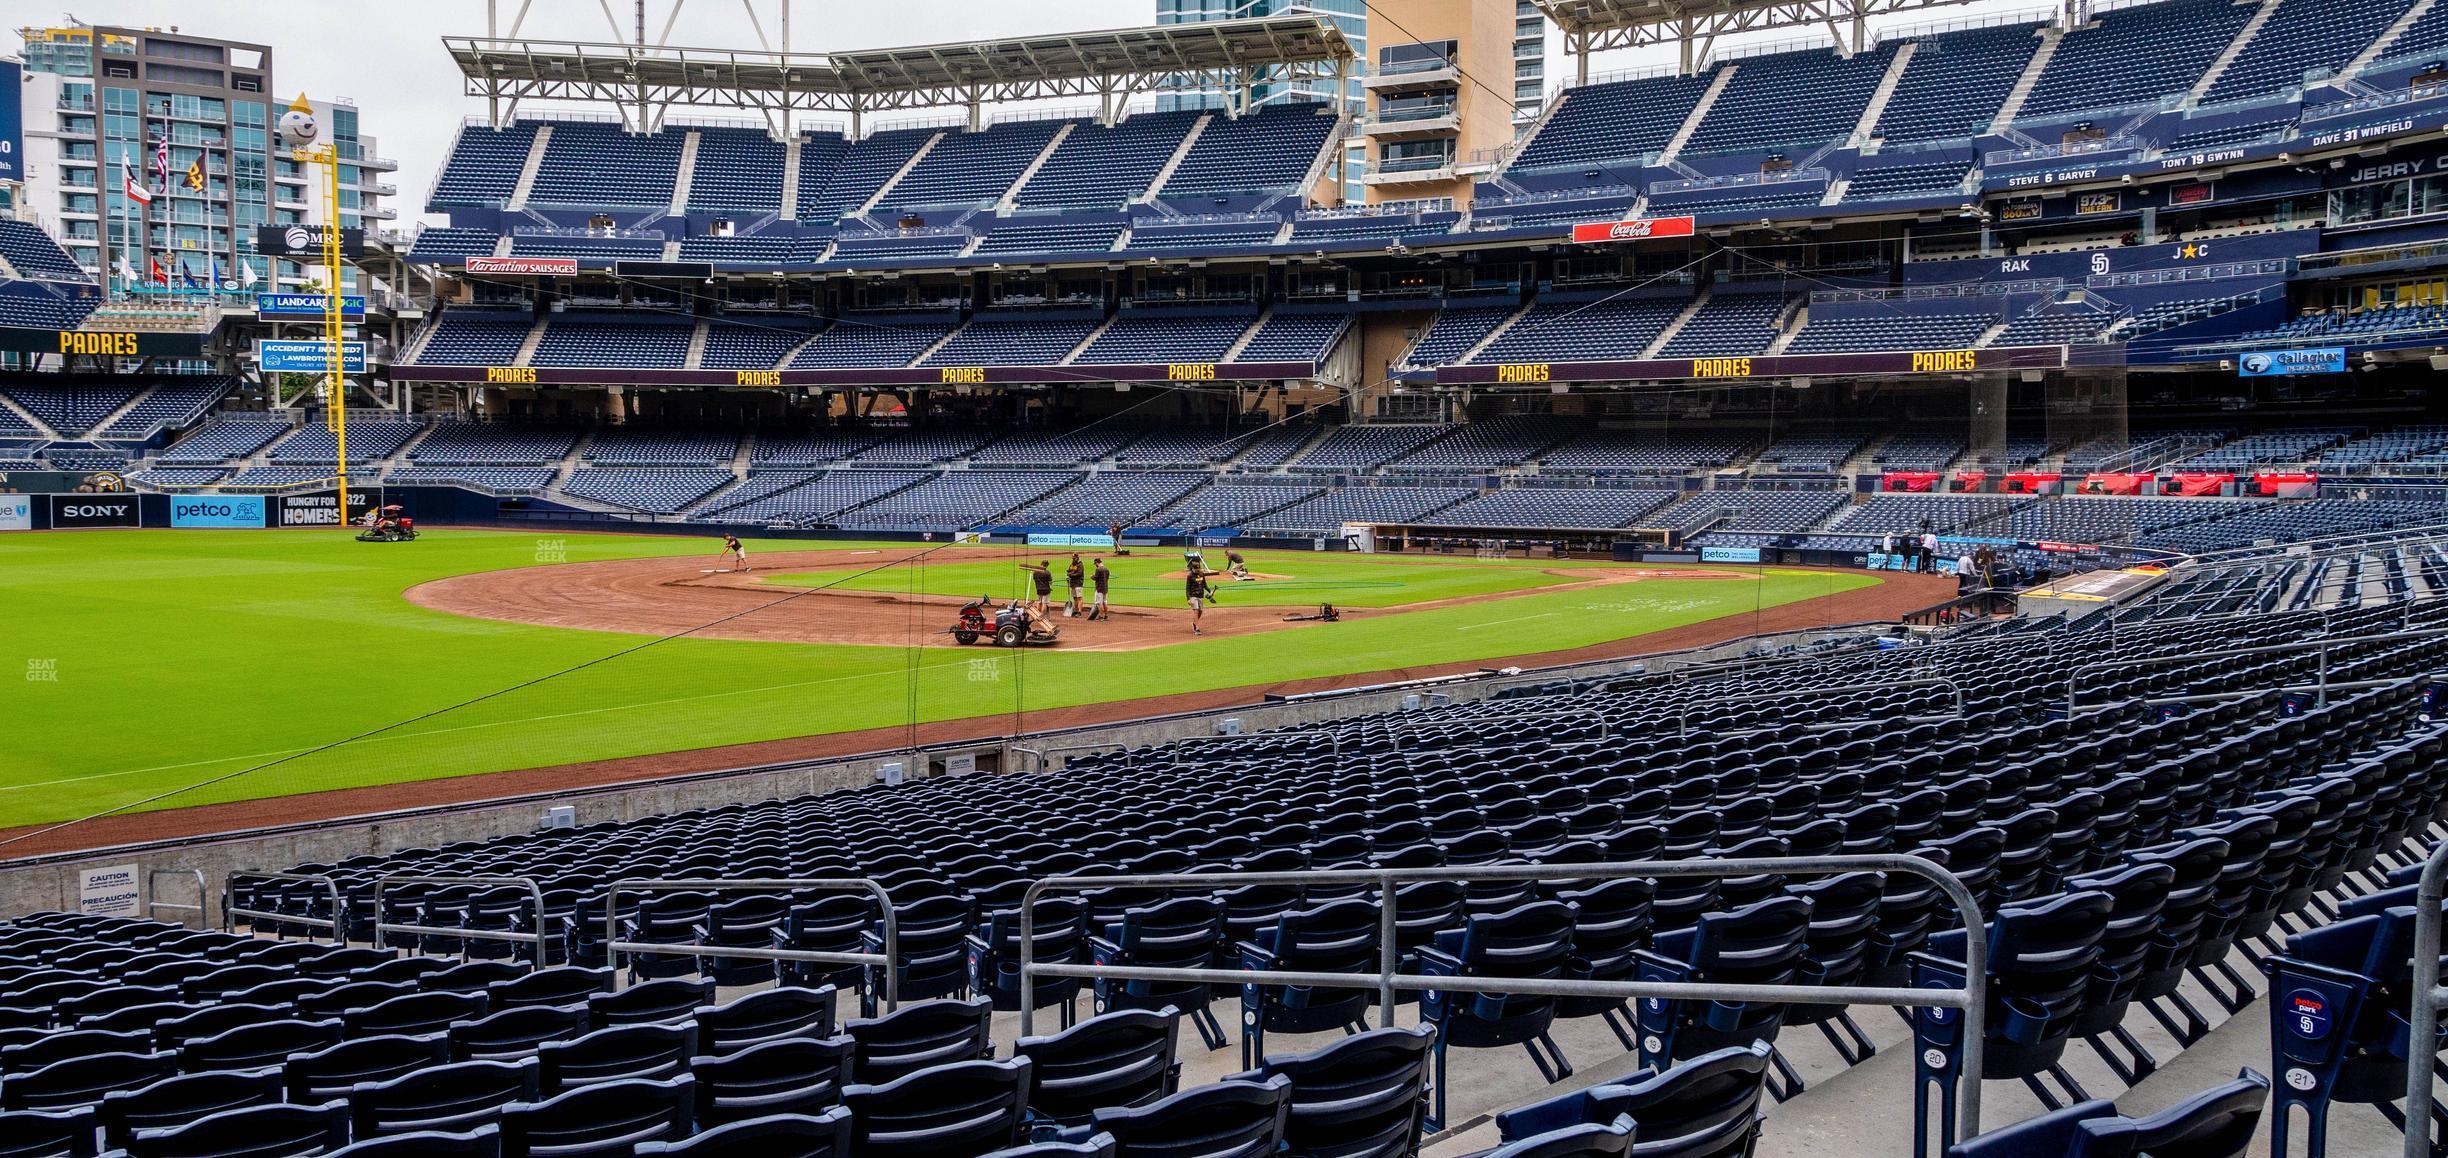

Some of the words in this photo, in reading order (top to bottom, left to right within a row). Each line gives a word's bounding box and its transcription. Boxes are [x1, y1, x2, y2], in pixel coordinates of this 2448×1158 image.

[2313, 133, 2340, 146] DAVE
[2344, 129, 2358, 141] 31
[2361, 121, 2412, 138] WINFIELD
[2161, 157, 2187, 168] TONY
[2191, 154, 2204, 165] 19
[2207, 149, 2244, 162] GWYNN
[2009, 175, 2039, 186] STEVE
[2045, 173, 2053, 183] 6
[2058, 169, 2097, 181] GARVEY
[2351, 159, 2424, 182] JERRY
[2081, 206, 2095, 214] THE
[2097, 204, 2113, 212] FAN
[1610, 221, 1654, 239] Coca-Cola
[470, 259, 528, 273] Tarantino
[529, 264, 575, 274] SAUSAGES
[2001, 259, 2030, 273] RAK
[60, 331, 137, 354] PADRES
[265, 344, 316, 353] ACCIDENT?
[1694, 359, 1750, 377] PADRES
[1913, 351, 1975, 372] PADRES
[488, 368, 536, 383] PADRES
[737, 371, 780, 385] PADRES
[943, 368, 984, 383] PADRES
[1169, 364, 1215, 380] PADRES
[1499, 365, 1549, 382] PADRES
[287, 497, 318, 507] HUNGRY
[320, 496, 336, 506] FOR
[347, 494, 366, 505] 322
[64, 505, 128, 518] SONY
[177, 501, 231, 520] petco
[284, 508, 340, 525] HOMERS
[1028, 536, 1048, 544] petco
[1072, 537, 1092, 545] petco
[1704, 550, 1730, 560] petco
[90, 872, 129, 882] CAUTION
[82, 892, 138, 905] PRECAUCIÓN
[2295, 998, 2322, 1010] petco
[2299, 1004, 2316, 1014] park
[1929, 1052, 1942, 1065] 20
[2294, 1072, 2308, 1086] 21
